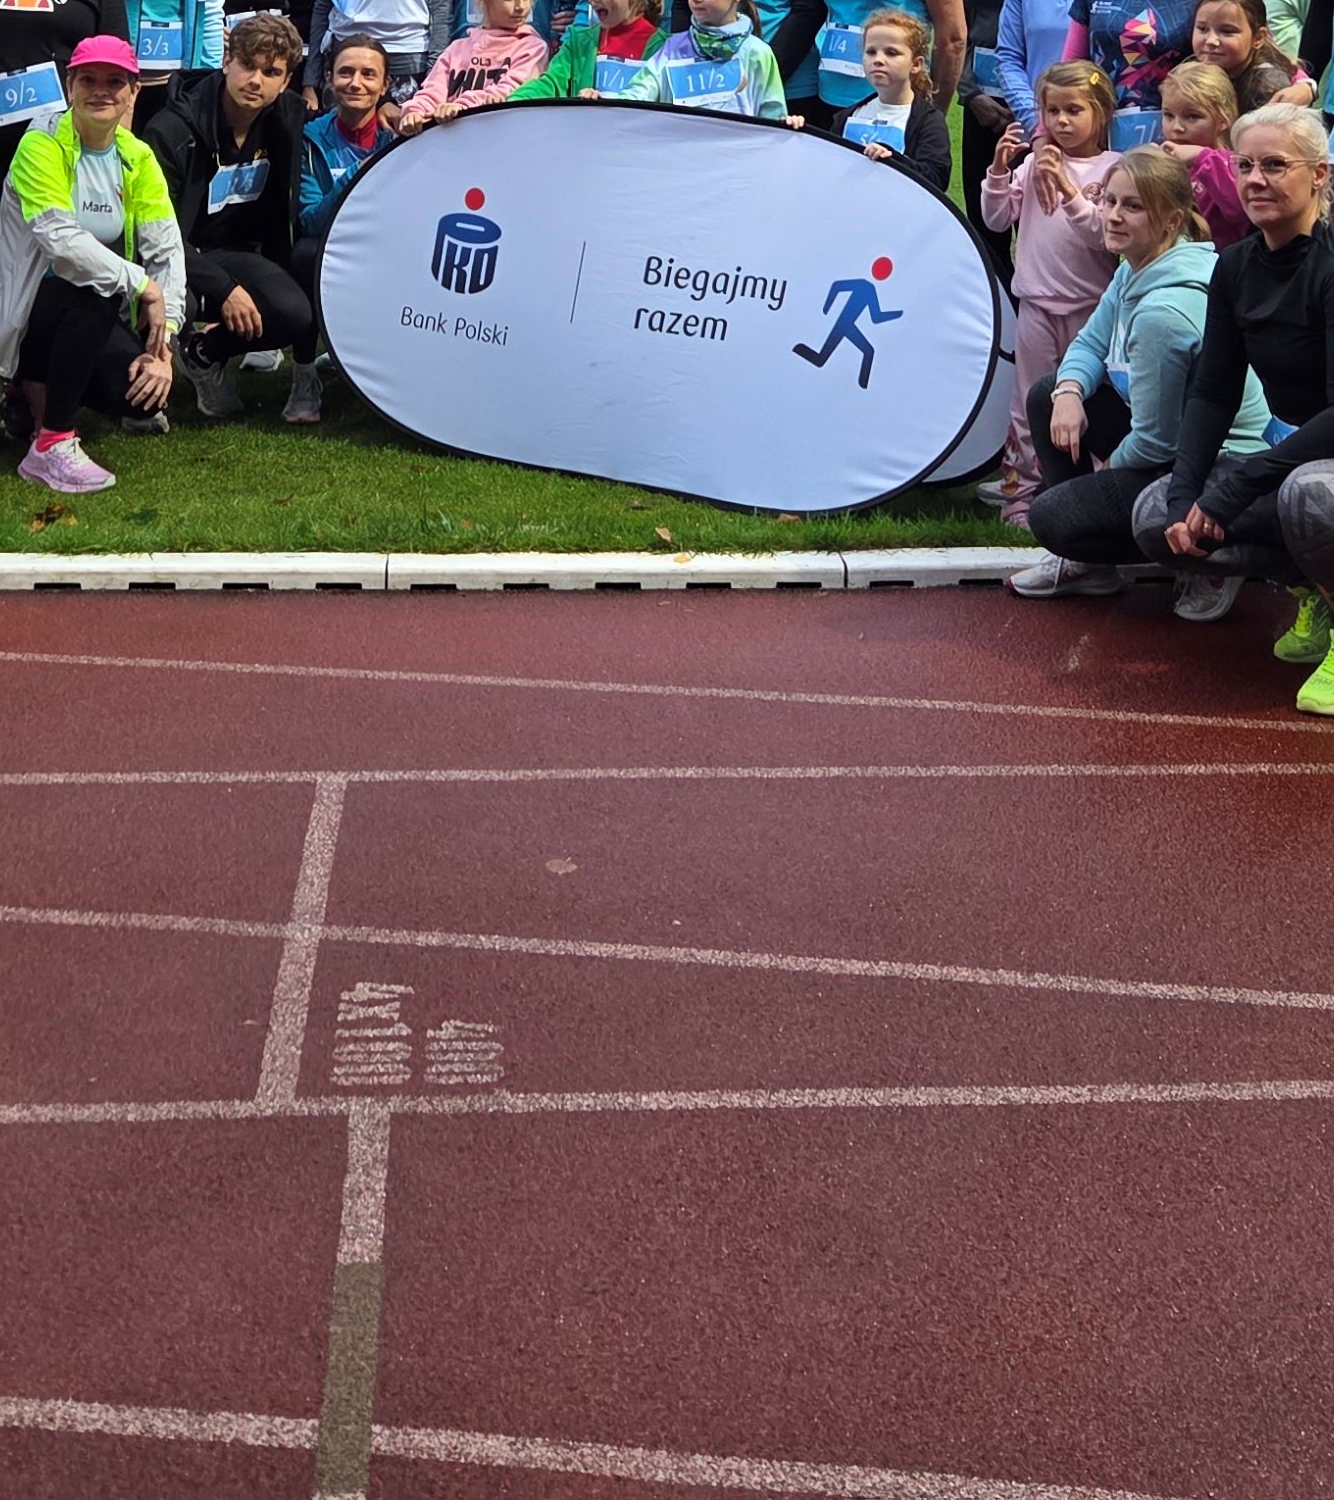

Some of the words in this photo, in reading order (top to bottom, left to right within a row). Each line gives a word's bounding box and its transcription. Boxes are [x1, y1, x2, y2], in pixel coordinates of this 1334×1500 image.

[142, 32, 169, 56] 3/3
[684, 66, 726, 94] 11/2
[4, 82, 38, 109] 9/2
[82, 200, 113, 214] Marta
[642, 255, 787, 311] Biegajmy
[400, 306, 448, 335] Bank
[454, 316, 509, 347] Polski
[633, 307, 729, 341] razem
